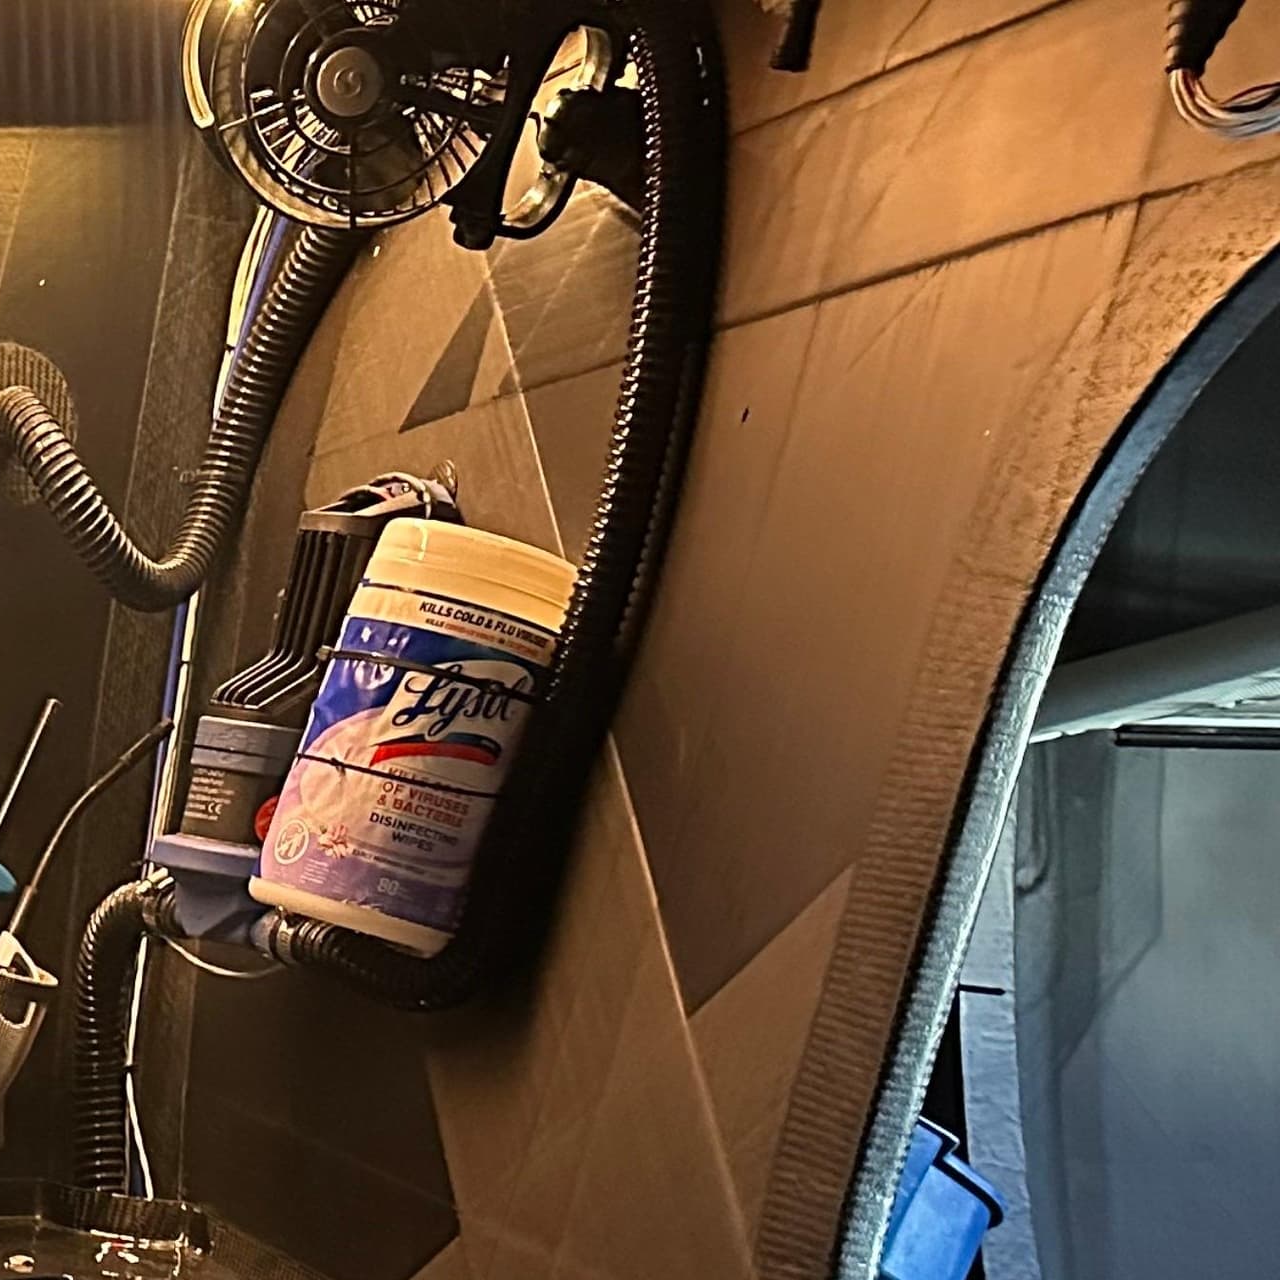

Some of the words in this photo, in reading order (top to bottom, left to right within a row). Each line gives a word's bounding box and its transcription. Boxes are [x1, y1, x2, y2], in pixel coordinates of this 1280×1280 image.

[419, 601, 453, 617] KILLS
[453, 609, 485, 626] COLD
[484, 619, 493, 629] &
[493, 621, 515, 636] FLU
[392, 664, 528, 736] Lysol
[377, 794, 387, 806] &
[382, 781, 405, 795] OF
[409, 788, 469, 816] VIRUSES
[391, 831, 434, 852] WIPES
